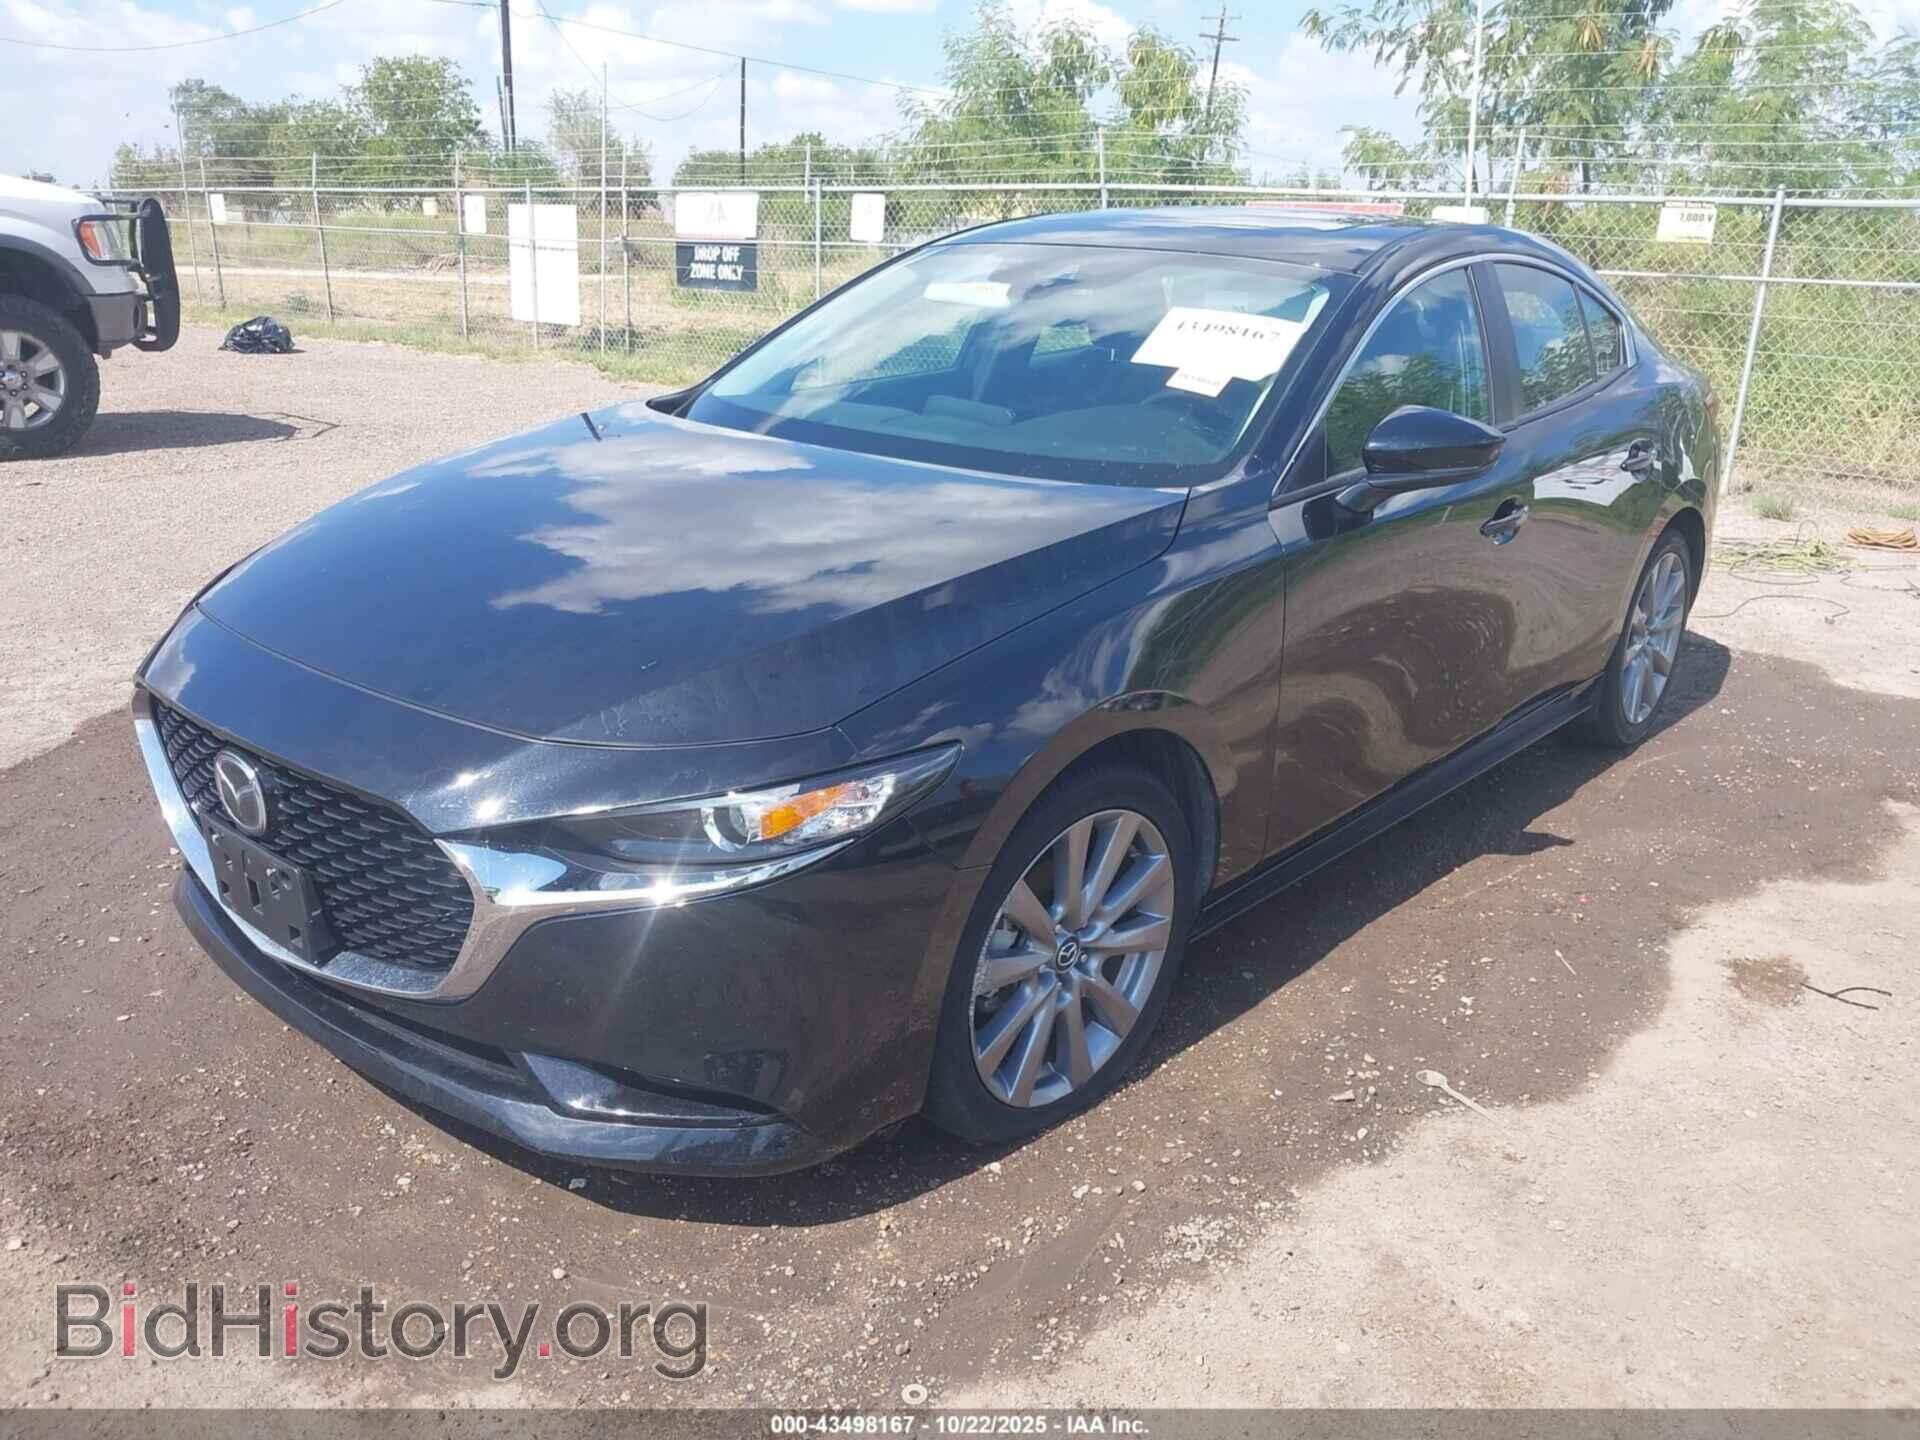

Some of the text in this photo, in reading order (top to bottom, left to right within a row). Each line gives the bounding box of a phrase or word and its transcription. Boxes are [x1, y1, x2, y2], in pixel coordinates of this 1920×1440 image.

[694, 246, 741, 262] DROP OFF
[690, 263, 744, 280] ZONE ONLY
